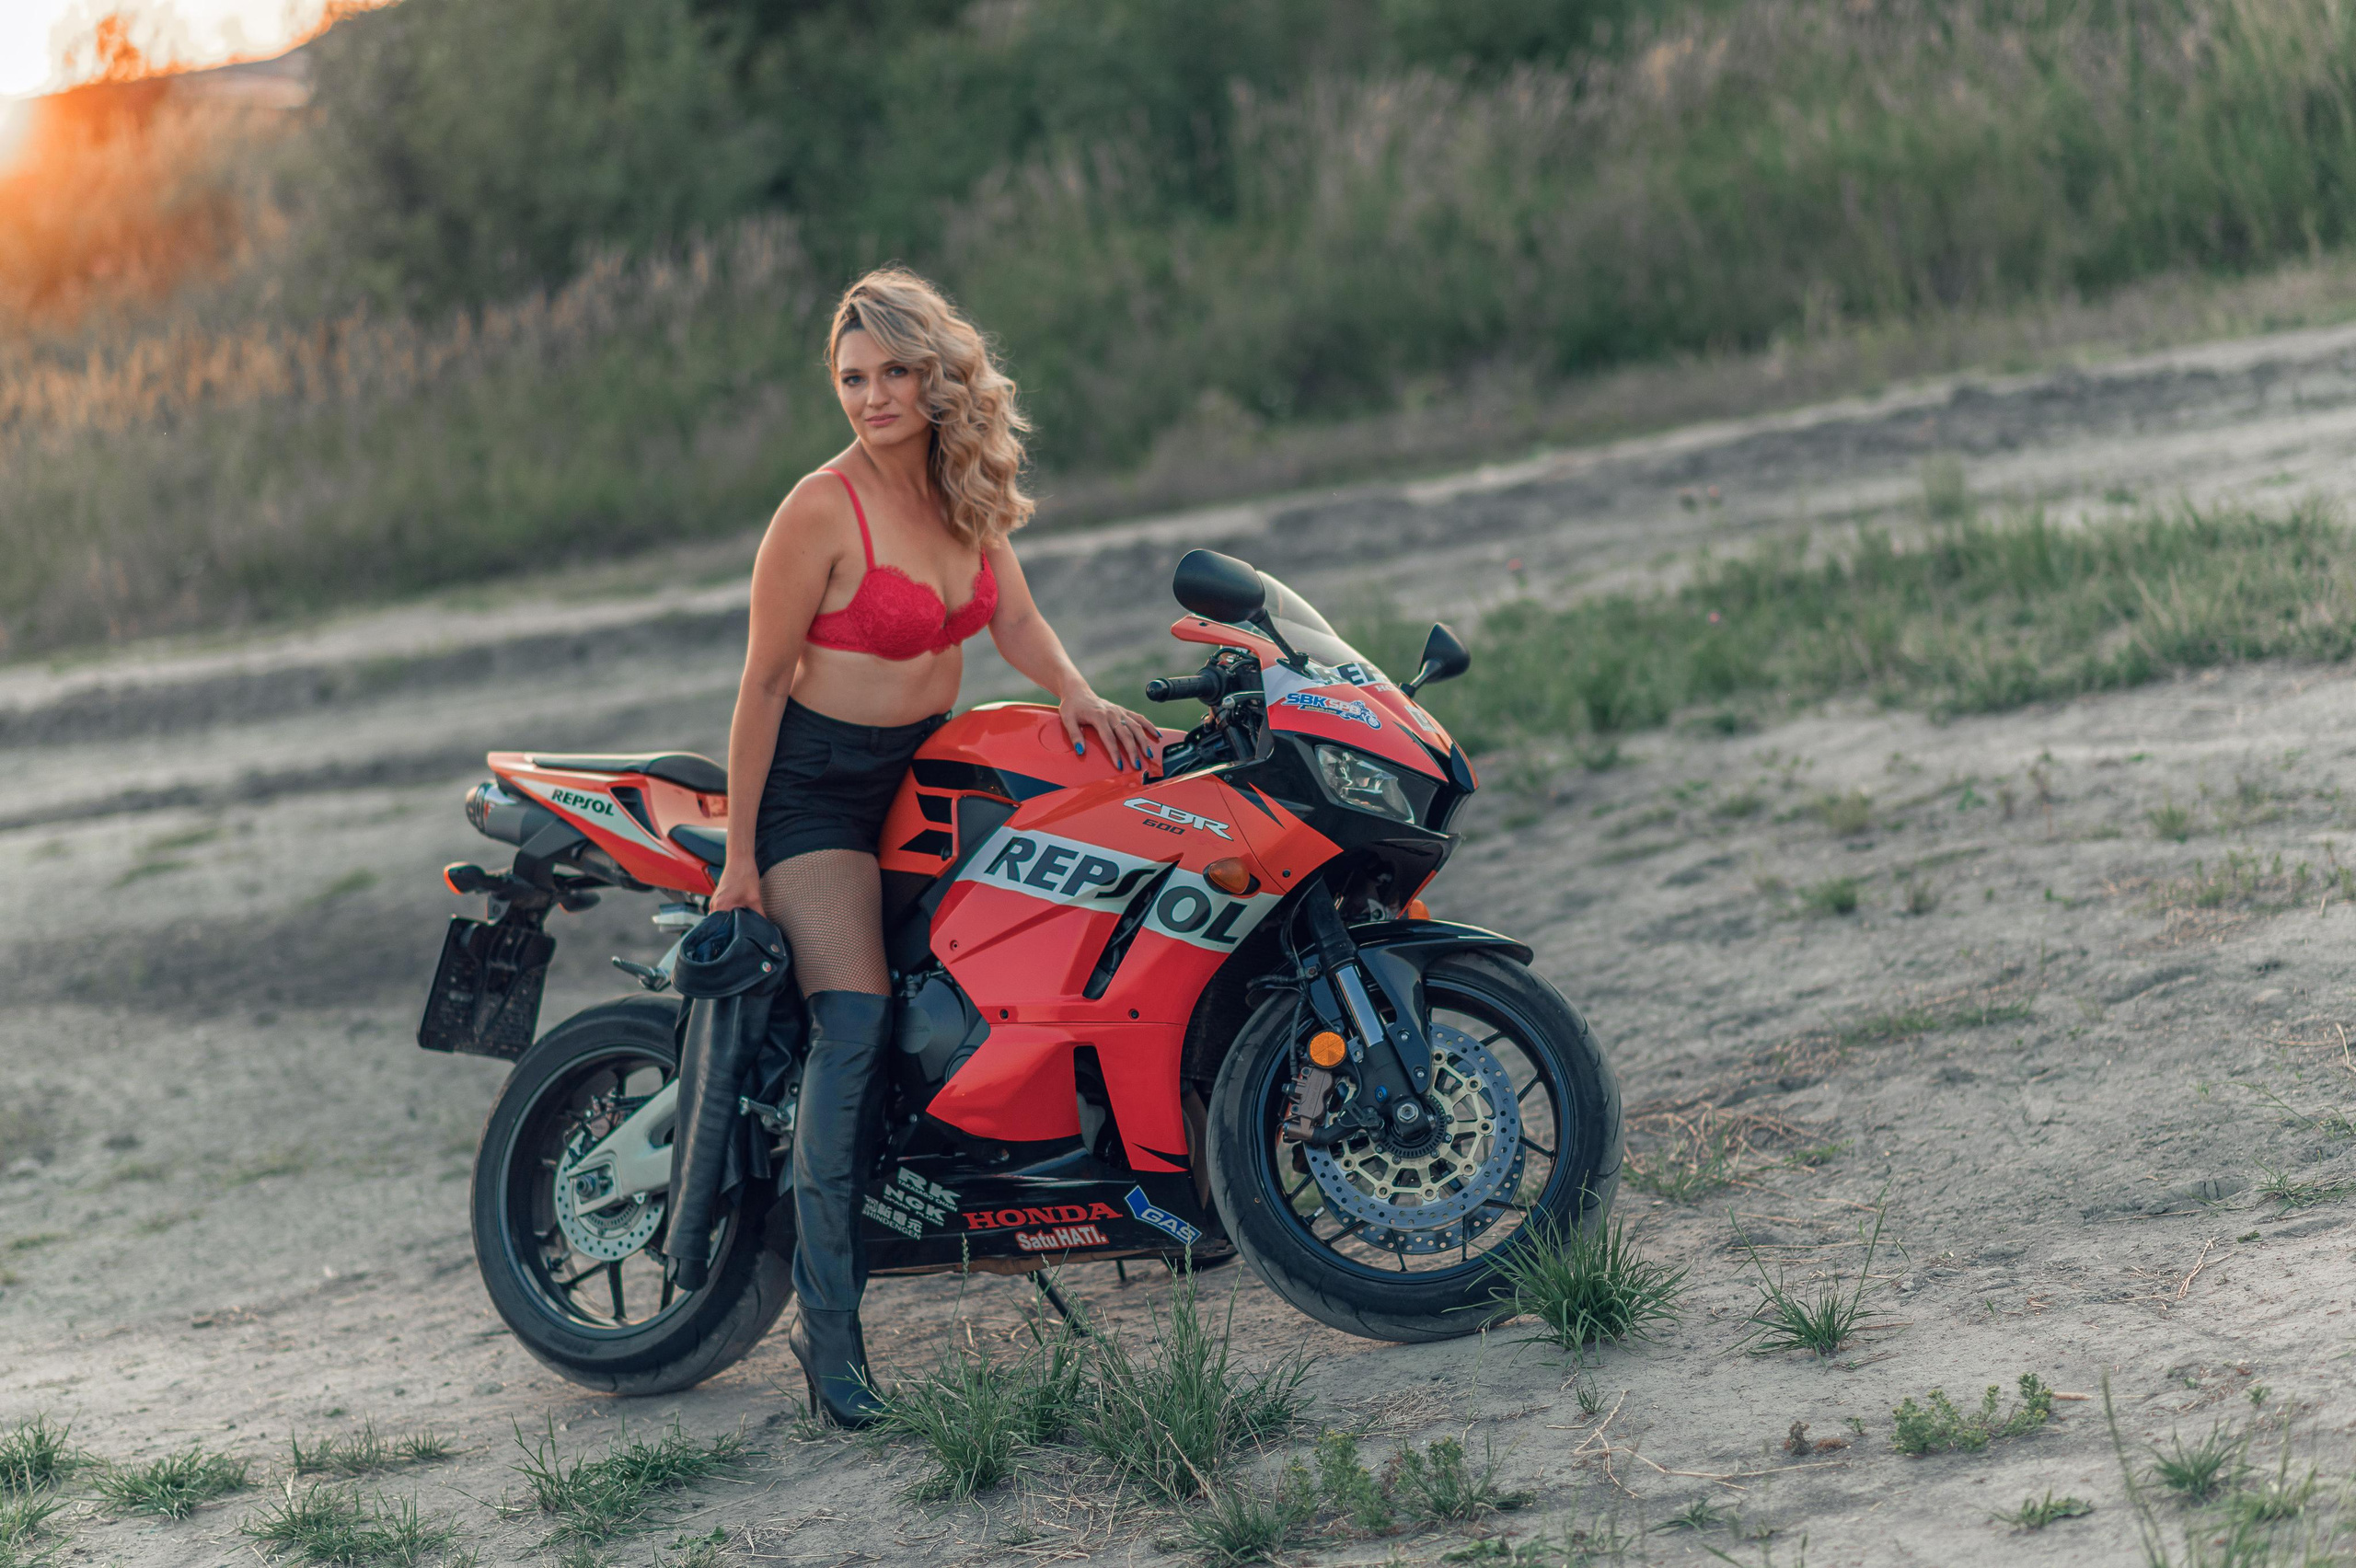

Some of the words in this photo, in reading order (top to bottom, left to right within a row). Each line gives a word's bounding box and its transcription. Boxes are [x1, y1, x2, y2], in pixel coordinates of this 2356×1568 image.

[552, 789, 615, 816] REPSOL
[1123, 797, 1234, 841] CBR
[1142, 818, 1185, 835] 600
[984, 836, 1249, 945] REPSOL
[898, 1166, 962, 1205] RK
[898, 1179, 934, 1201] TAKASAGO
[935, 1199, 958, 1212] CHAIN
[884, 1183, 946, 1222] NGK
[884, 1195, 911, 1211] SPARK
[916, 1211, 944, 1227] PLUGS
[962, 1202, 1124, 1229] HONDA
[862, 1209, 921, 1240] SHINDENGEN
[1140, 1208, 1196, 1242] GAS
